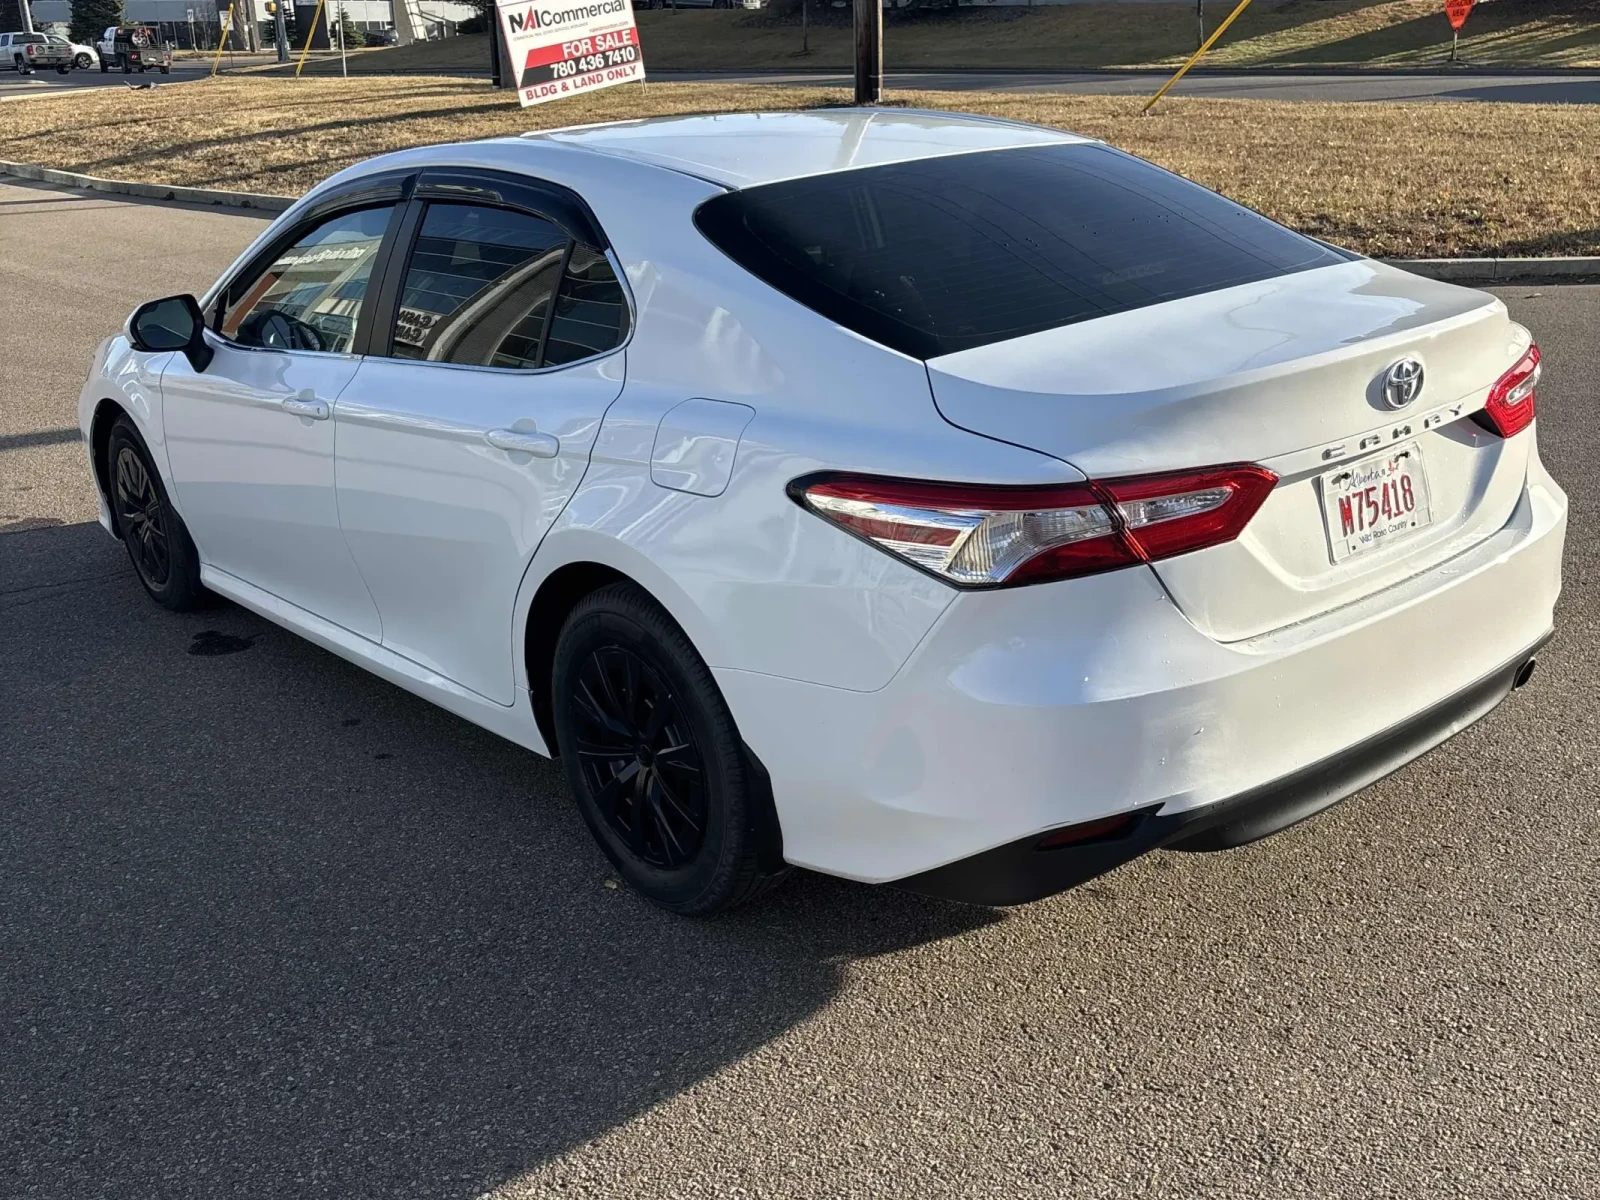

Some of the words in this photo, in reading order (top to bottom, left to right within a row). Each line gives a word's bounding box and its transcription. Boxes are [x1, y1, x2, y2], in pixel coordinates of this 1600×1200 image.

[562, 38, 592, 59] FOR
[595, 30, 633, 50] SALE
[550, 61, 576, 79] 780
[578, 54, 604, 71] 436
[605, 47, 636, 66] 7410
[525, 82, 558, 101] BLDG
[561, 82, 570, 92] &
[573, 72, 604, 89] LAND
[607, 65, 637, 81] ONLY
[1322, 403, 1464, 461] CAMRY
[1338, 474, 1415, 538] M75418
[1358, 532, 1372, 544] Wild
[1373, 529, 1387, 539] Rose
[1388, 519, 1408, 534] Country
